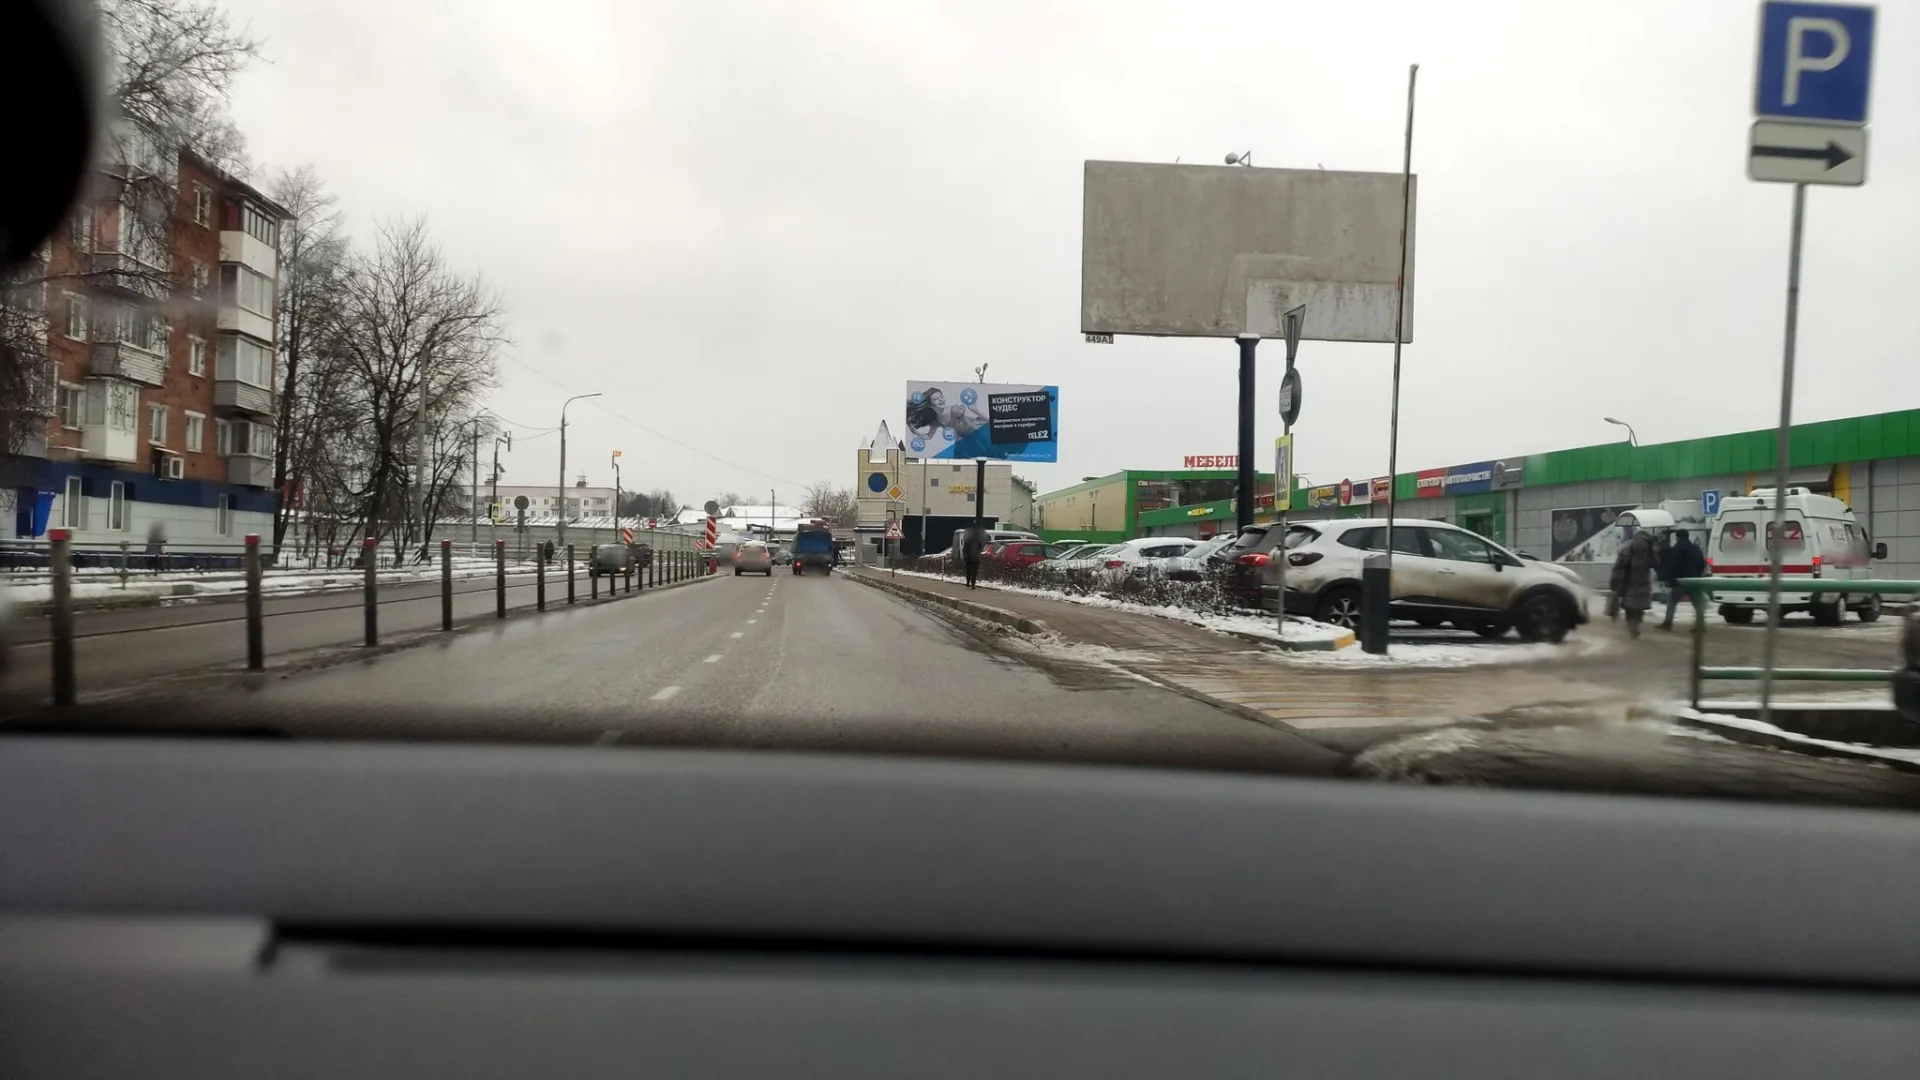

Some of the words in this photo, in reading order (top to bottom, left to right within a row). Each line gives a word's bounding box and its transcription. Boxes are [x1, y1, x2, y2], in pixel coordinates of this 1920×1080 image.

[1782, 17, 1851, 106] P
[992, 395, 1046, 404] КОНСТРУКТОР
[992, 404, 1018, 412] ЧУДЕС
[1027, 430, 1048, 439] TELE2
[1706, 493, 1716, 512] P
